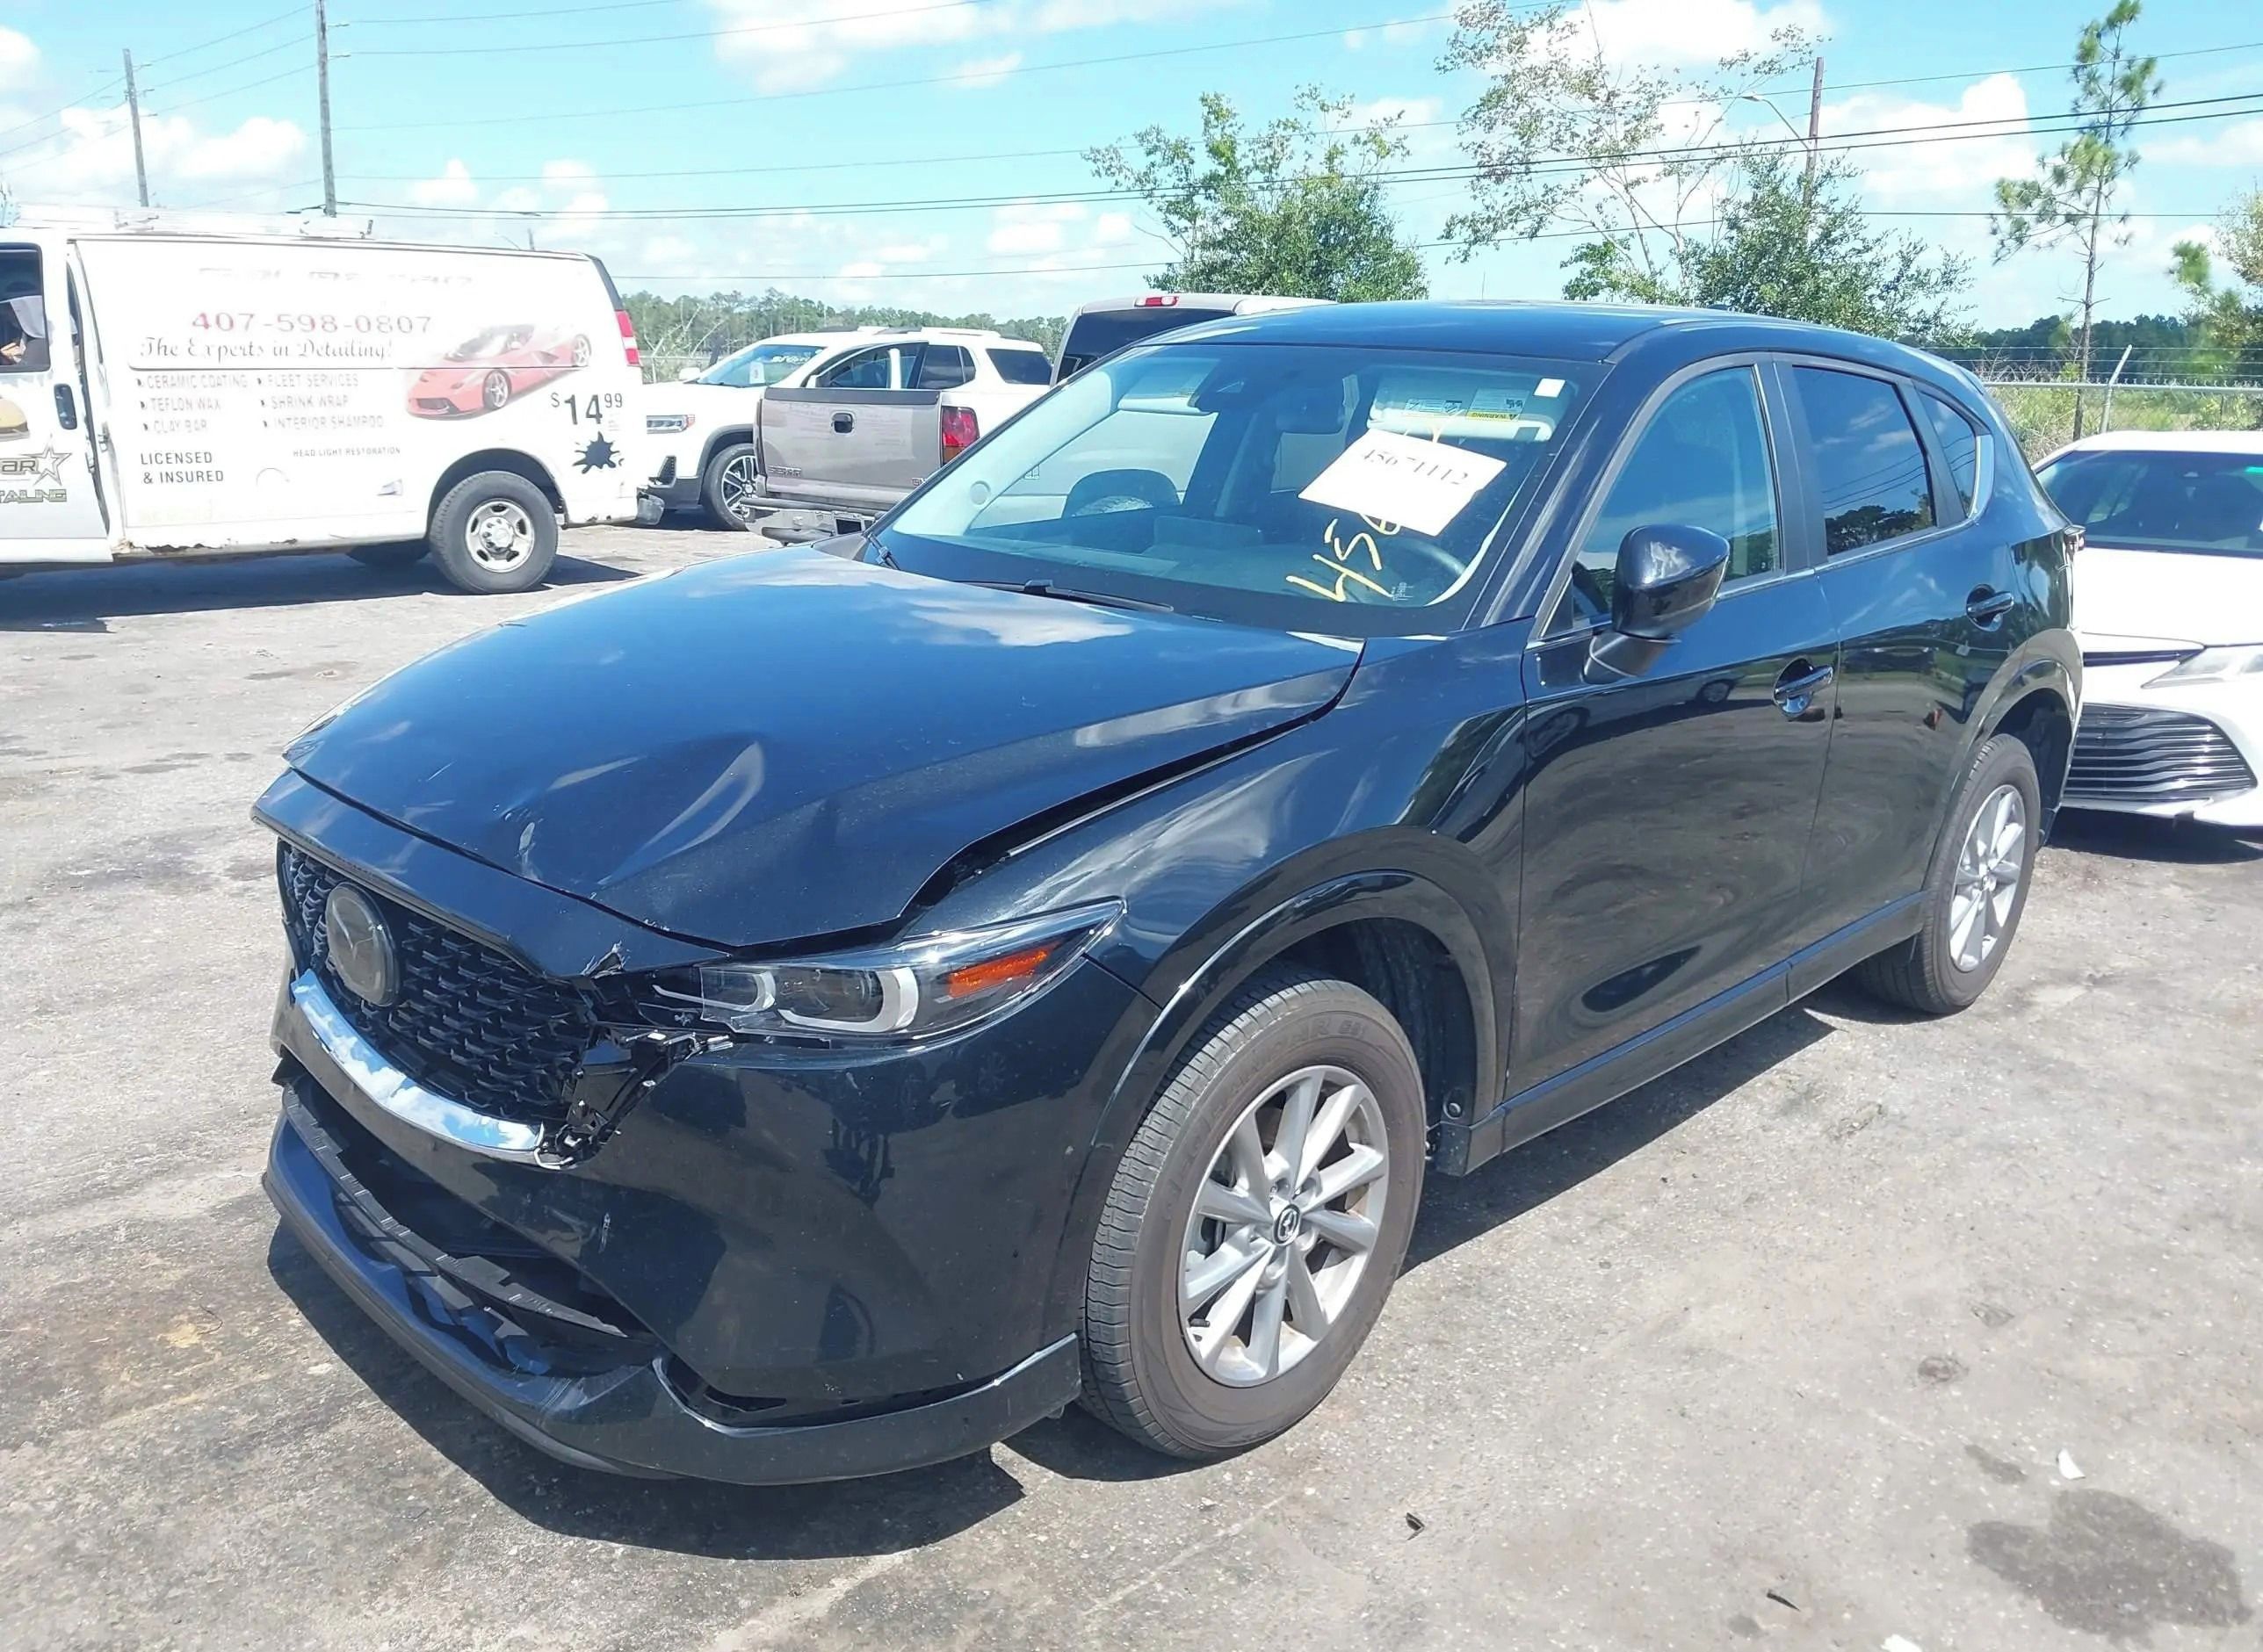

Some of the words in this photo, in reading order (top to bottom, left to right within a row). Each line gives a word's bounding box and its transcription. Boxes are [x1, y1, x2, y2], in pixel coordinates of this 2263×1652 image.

[192, 313, 431, 334] 407-598-0807
[141, 336, 178, 357] The
[188, 337, 264, 363] Experts
[273, 340, 289, 357] in
[148, 374, 198, 389] CERAMIC
[200, 373, 248, 388] COATING
[268, 373, 300, 387] FLEET
[307, 373, 358, 387] SERVICES
[150, 397, 192, 411] TEFLON
[197, 397, 221, 410] WAX
[271, 395, 313, 409] SHRINK
[318, 394, 349, 408] WRAP
[154, 419, 180, 433] CLAY
[274, 416, 327, 429] INTERIOR
[330, 415, 385, 429] SHAMPOO
[345, 445, 401, 456] RESTORATION
[141, 451, 213, 465] LICENSED
[143, 472, 154, 484] &
[160, 470, 224, 484] INSURED
